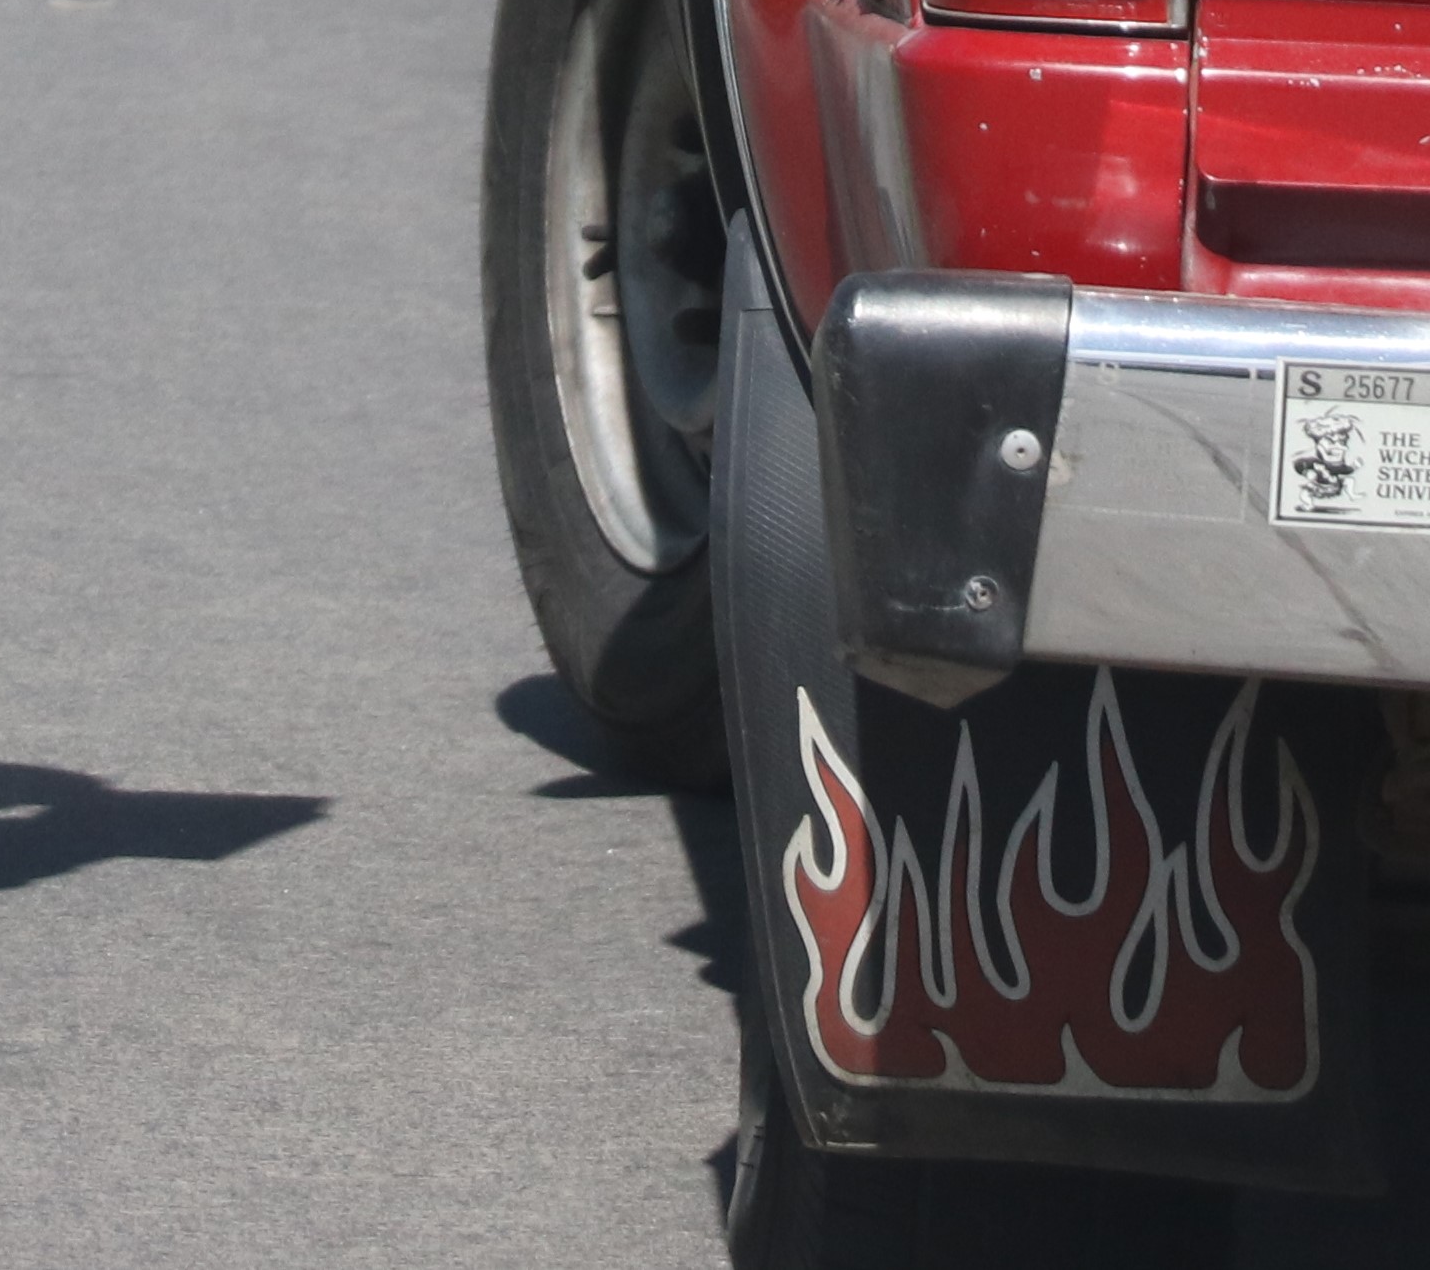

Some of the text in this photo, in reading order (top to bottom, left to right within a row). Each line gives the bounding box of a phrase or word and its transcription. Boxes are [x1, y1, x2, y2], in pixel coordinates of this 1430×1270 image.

[1298, 370, 1323, 397] S
[1343, 374, 1415, 401] 25677
[1379, 431, 1422, 448] THE
